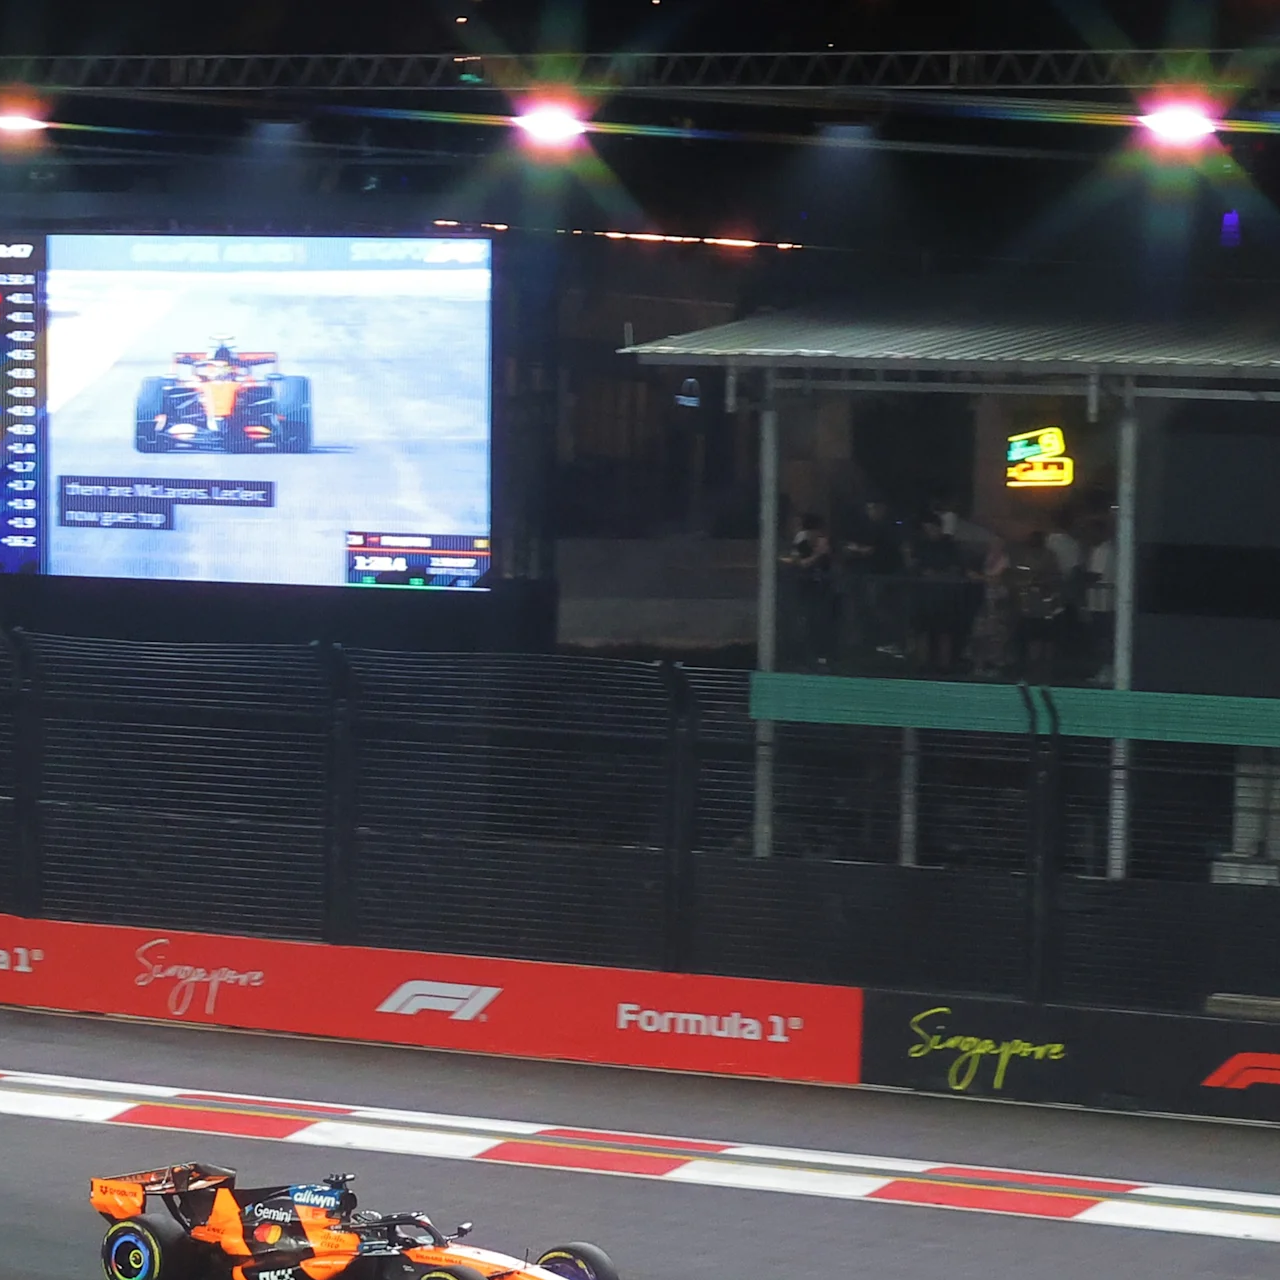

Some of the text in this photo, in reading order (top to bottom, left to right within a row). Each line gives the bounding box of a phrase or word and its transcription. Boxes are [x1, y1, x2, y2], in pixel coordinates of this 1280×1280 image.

[134, 938, 266, 1016] Singapore
[616, 1002, 763, 1041] Formula
[907, 1007, 1068, 1091] Singapore
[254, 1203, 293, 1223] Gemini
[293, 1190, 335, 1208] allwyn
